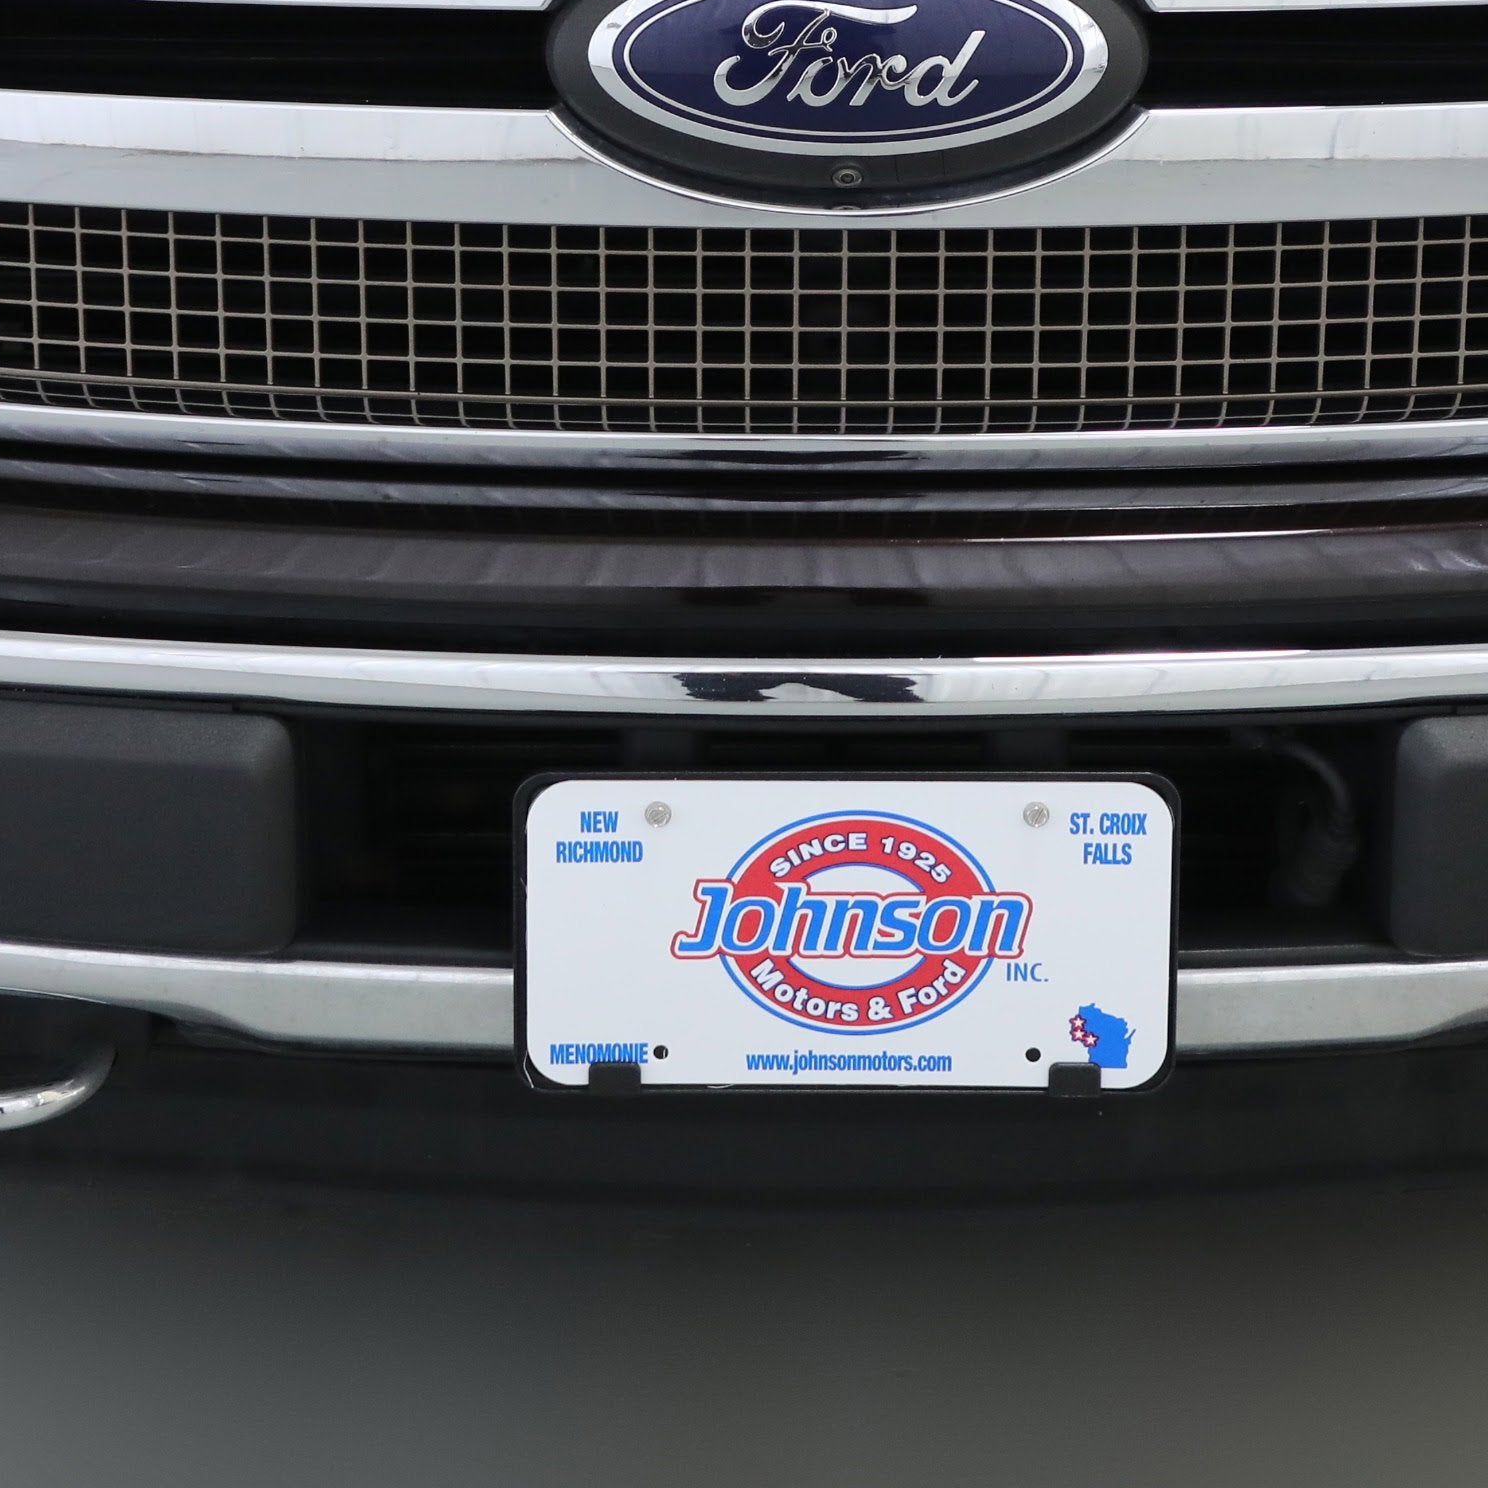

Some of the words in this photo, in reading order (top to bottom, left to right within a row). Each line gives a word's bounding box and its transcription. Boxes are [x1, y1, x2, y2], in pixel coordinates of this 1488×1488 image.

[713, 0, 985, 106] Ford
[580, 811, 619, 833] NEW
[1069, 812, 1094, 835] ST.
[1099, 812, 1148, 835] CROIX
[556, 841, 643, 863] RICHMOND
[769, 832, 868, 879] SINCE
[881, 834, 952, 884] 1925
[1083, 842, 1132, 865] FALLS
[675, 882, 1026, 953] Johnson
[1006, 962, 1049, 982] INC.
[748, 959, 860, 1022] Motors
[866, 996, 892, 1020] &
[897, 960, 967, 1014] Ford
[550, 1043, 648, 1064] MENOMONIE
[746, 1050, 952, 1074] www.johnsonmotors.com
